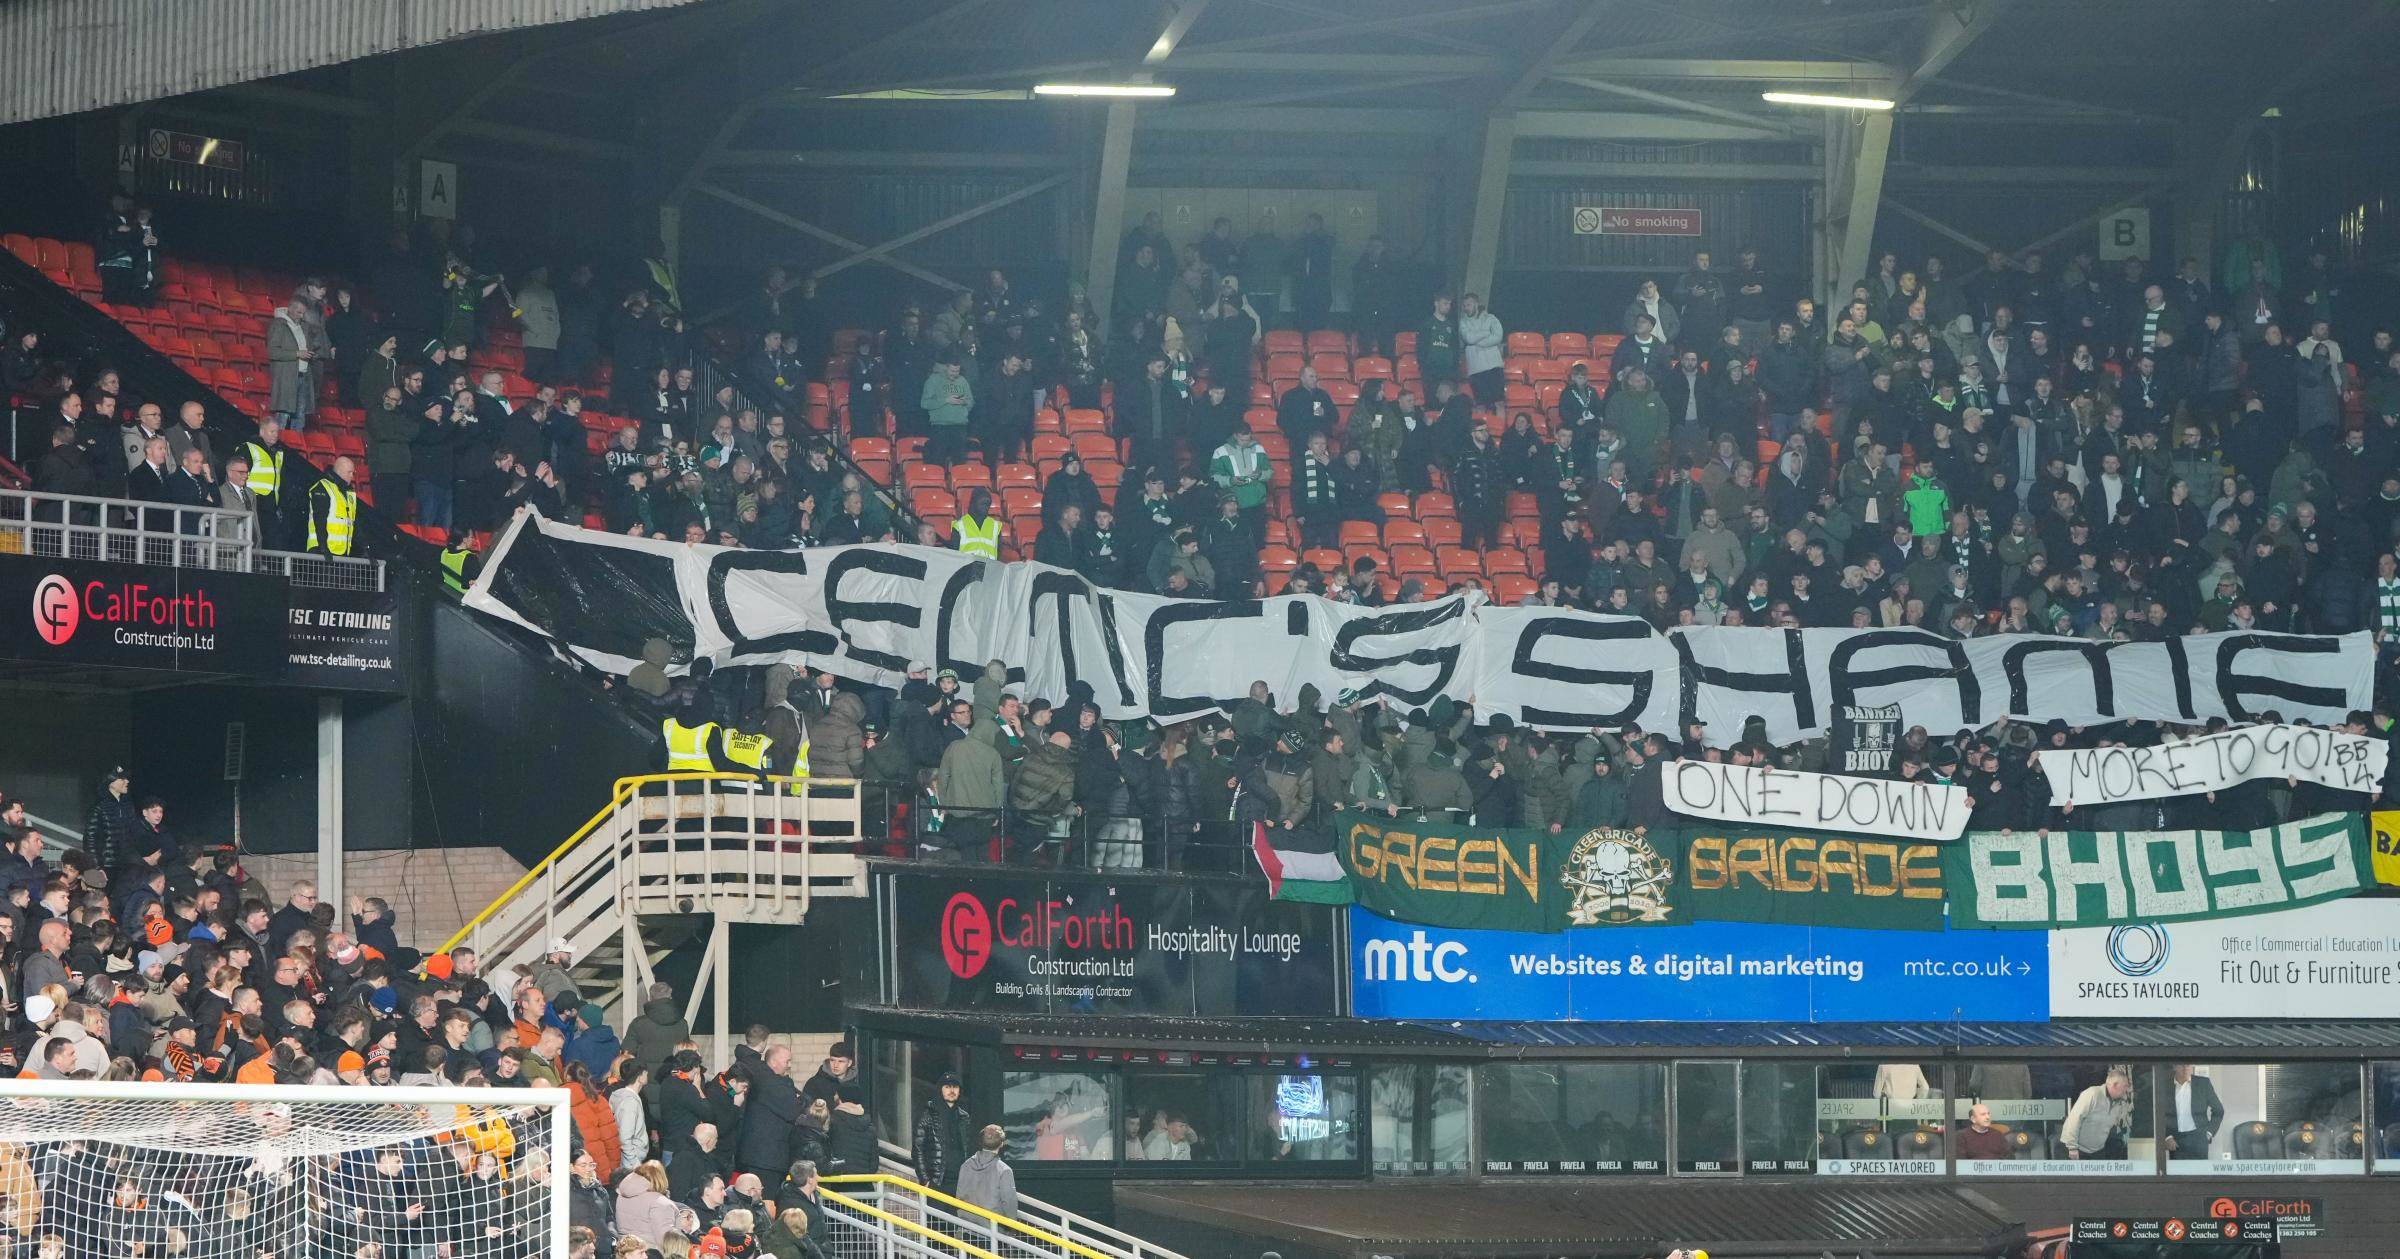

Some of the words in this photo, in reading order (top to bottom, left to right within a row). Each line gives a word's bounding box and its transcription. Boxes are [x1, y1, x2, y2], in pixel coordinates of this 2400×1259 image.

[121, 145, 132, 167] A
[432, 173, 447, 204] A
[1612, 215, 1629, 227] No
[1635, 215, 1688, 230] smoking
[2114, 218, 2136, 246] B
[84, 580, 215, 629] CalForth
[318, 610, 392, 631] DETAILING
[114, 627, 192, 649] Construction
[195, 633, 215, 650] Ltd
[1511, 616, 2348, 729] SHAME
[733, 740, 756, 751] SECURITY
[2334, 740, 2370, 766] BB
[1844, 750, 1893, 772] BHOY
[2069, 742, 2207, 801] MORE
[2195, 733, 2256, 781] TO
[2263, 725, 2334, 783] GO!
[2341, 763, 2374, 790] 14
[1678, 762, 1801, 817] ONE
[1818, 774, 1950, 831] DOWN
[1571, 830, 1604, 864] GREEN
[1604, 829, 1657, 862] BRIGADE
[1350, 823, 1539, 904] GREEN
[1690, 837, 1943, 900] BRIGADE
[1968, 811, 2361, 922] BHOYS
[997, 898, 1134, 950] CalForth
[1148, 923, 1238, 961] Hospitality
[1243, 925, 1301, 962] Lounge
[2221, 936, 2252, 954] Office
[2261, 936, 2322, 951] Commercial
[2332, 937, 2383, 952] Education
[1028, 954, 1110, 975] Construction
[1112, 957, 1134, 977] Ltd
[1364, 930, 1478, 984] mtc.
[1903, 955, 2013, 977] mtc.co.uk
[1509, 953, 1622, 976] Websites
[1627, 954, 1648, 976] &
[1654, 953, 1733, 981] digital
[1739, 954, 1864, 982] marketing
[2220, 960, 2243, 984] Fit
[2250, 960, 2281, 984] Out
[2286, 961, 2301, 984] &
[2308, 960, 2391, 984] Furniture
[995, 982, 1024, 998] Building,
[1025, 983, 1043, 996] Civils
[1052, 983, 1094, 1000] Landscaping
[1095, 984, 1133, 997] Contractor
[2078, 982, 2129, 999] SPACES
[2132, 982, 2200, 999] TAYLORED
[1487, 1161, 1512, 1170] FAVELA
[1524, 1161, 1549, 1170] FAVELA
[1560, 1161, 1586, 1170] FAVELA
[1597, 1161, 1622, 1170] FAVELA
[1633, 1161, 1658, 1170] FAVELA
[1696, 1162, 1721, 1171] FAVELA
[1752, 1161, 1777, 1170] FAVELA
[1784, 1161, 1809, 1170] FAVELA
[1850, 1161, 1886, 1174] SPACES
[1889, 1161, 1935, 1174] TAYLORED
[1973, 1162, 1993, 1173] Office
[1998, 1162, 2038, 1172] Commercial
[2043, 1162, 2075, 1172] Education
[2081, 1162, 2105, 1172] Leisure
[2114, 1162, 2134, 1172] Retail
[2212, 1161, 2317, 1173] www.spacestayloredcom
[2238, 1199, 2311, 1215] CalForth
[2080, 1221, 2106, 1229] Central
[2133, 1221, 2159, 1229] Central
[2191, 1221, 2217, 1229] Central
[2244, 1221, 2270, 1229] Central
[2078, 1230, 2107, 1239] Coaches
[2131, 1230, 2160, 1239] Coaches
[2189, 1230, 2219, 1239] Coaches
[2243, 1230, 2272, 1239] Coaches
